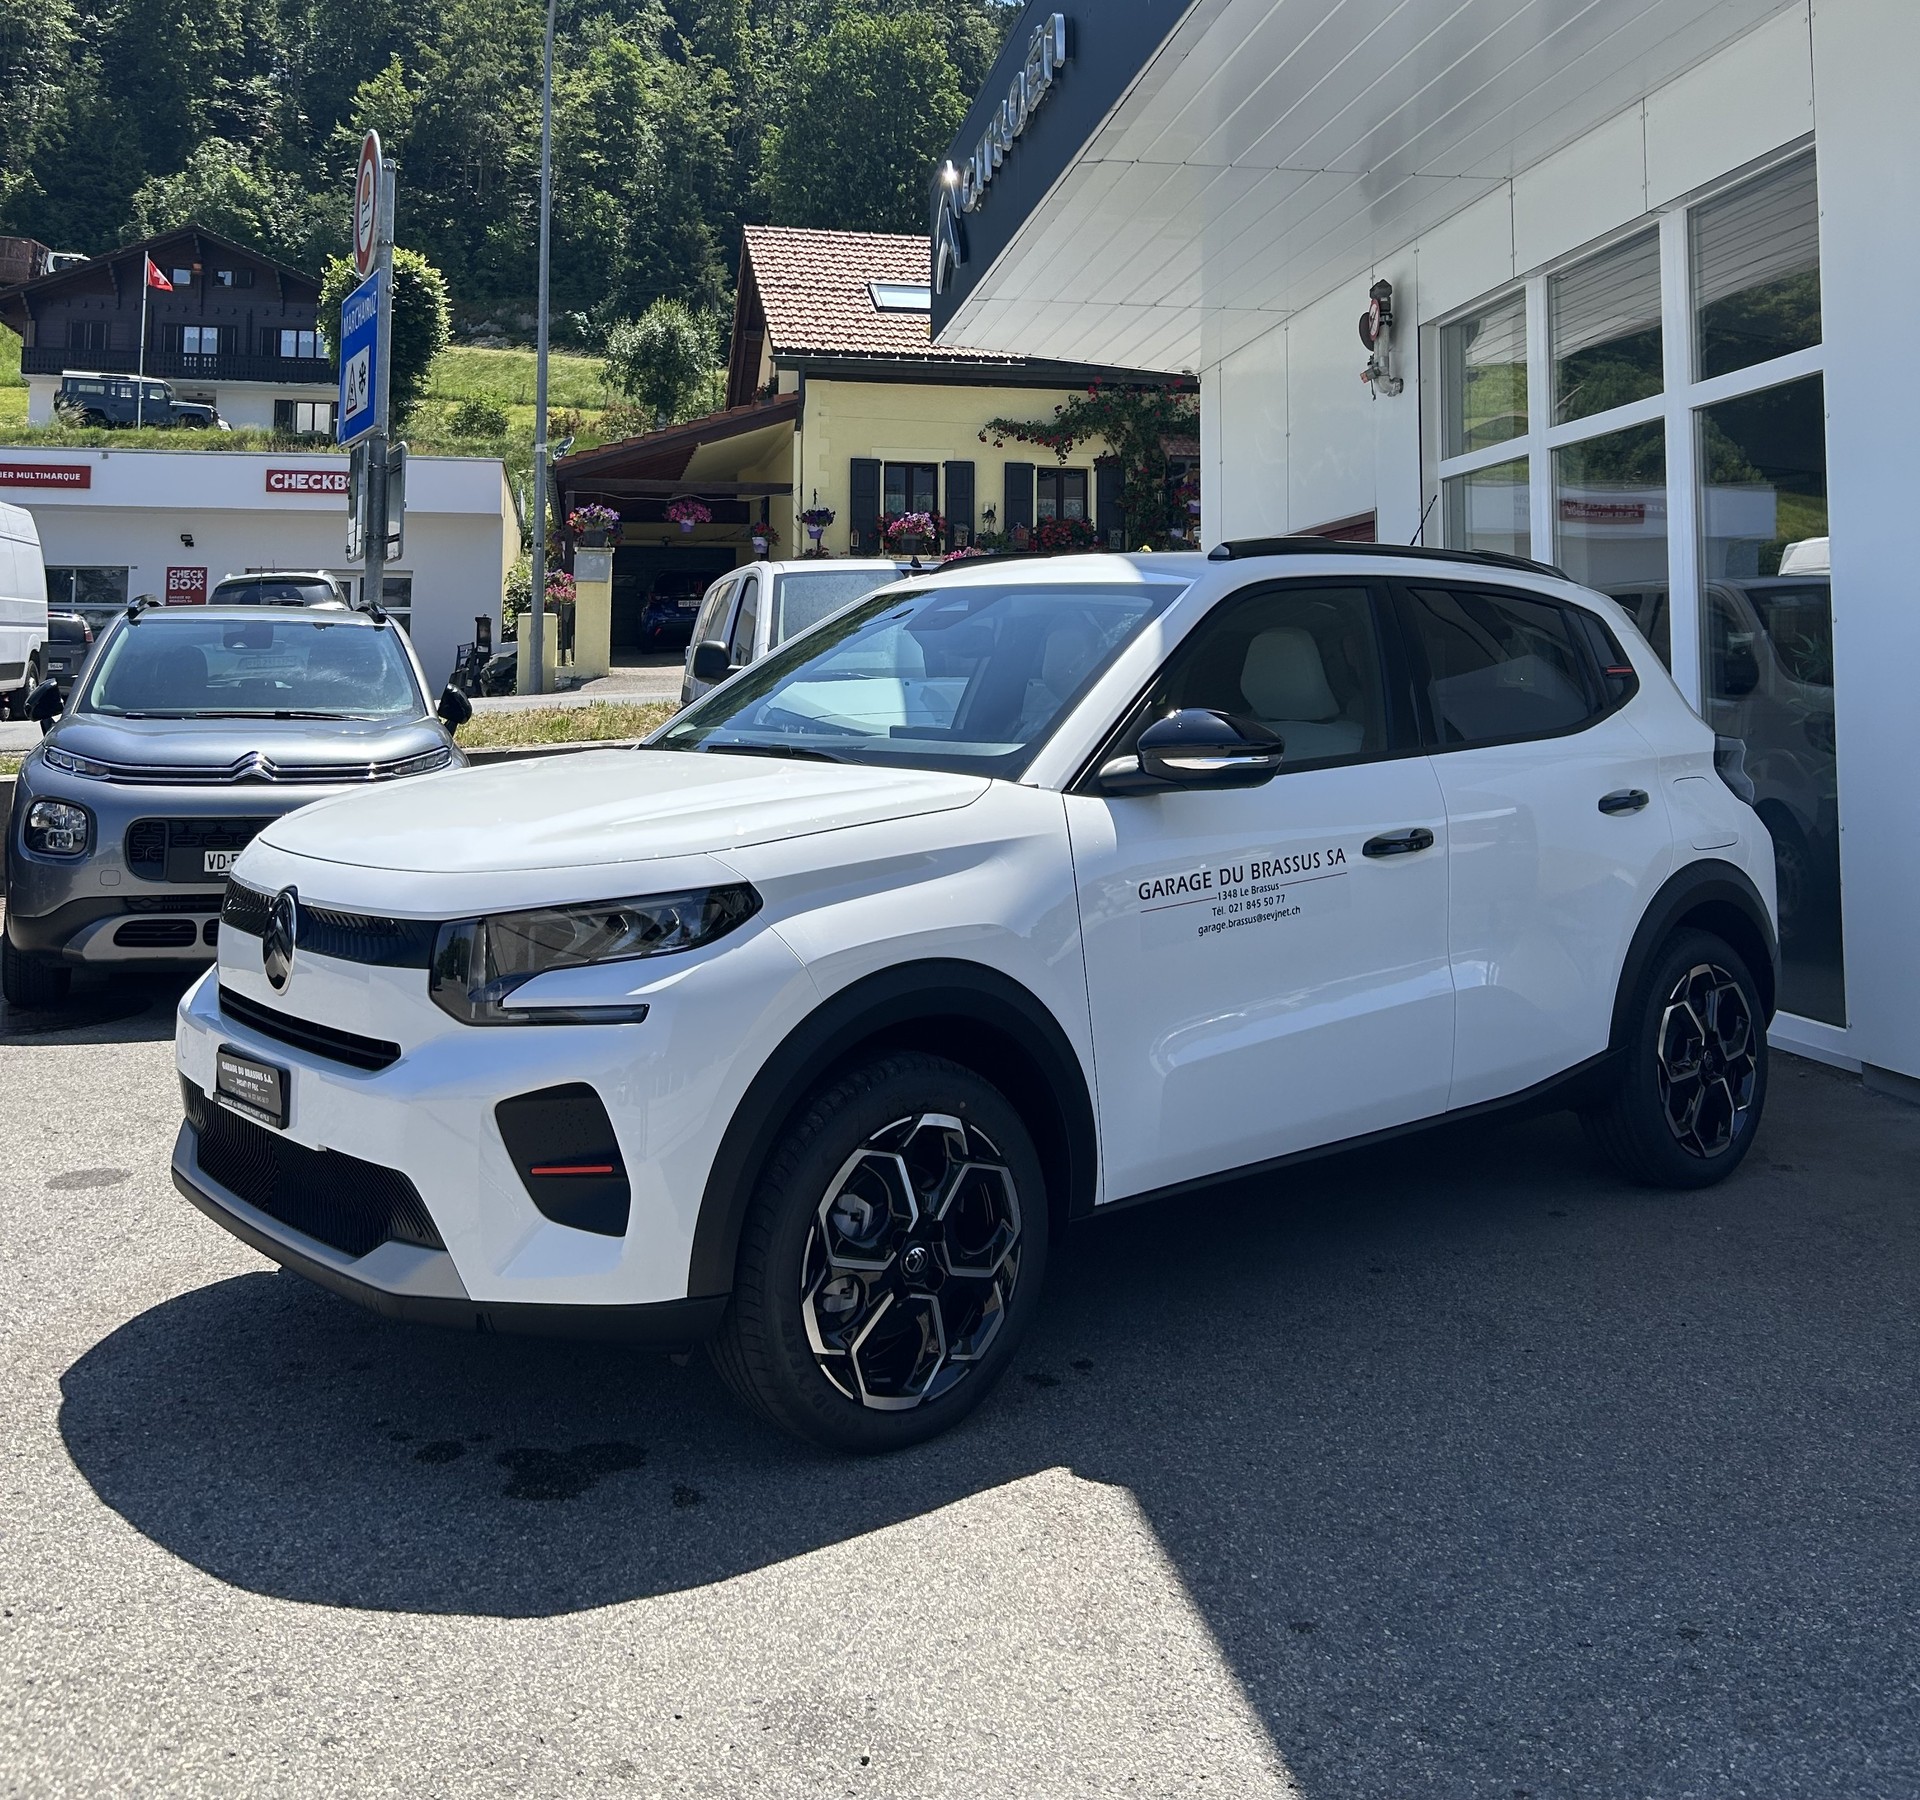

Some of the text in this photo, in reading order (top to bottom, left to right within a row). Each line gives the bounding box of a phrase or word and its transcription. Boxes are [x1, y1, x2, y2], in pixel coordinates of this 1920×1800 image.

[16, 472, 81, 481] MULTIMARQUE
[270, 473, 350, 490] CHECKB
[169, 570, 204, 579] CHECK
[169, 578, 204, 590] BOX
[1138, 848, 1347, 901] GARAGE DU BRASSUS SA
[1217, 883, 1280, 901] 1348 Le Brassus
[1212, 894, 1286, 917] Tél. 021 845 50 77
[1197, 905, 1301, 937] garage.brassus@sevjnet.ch
